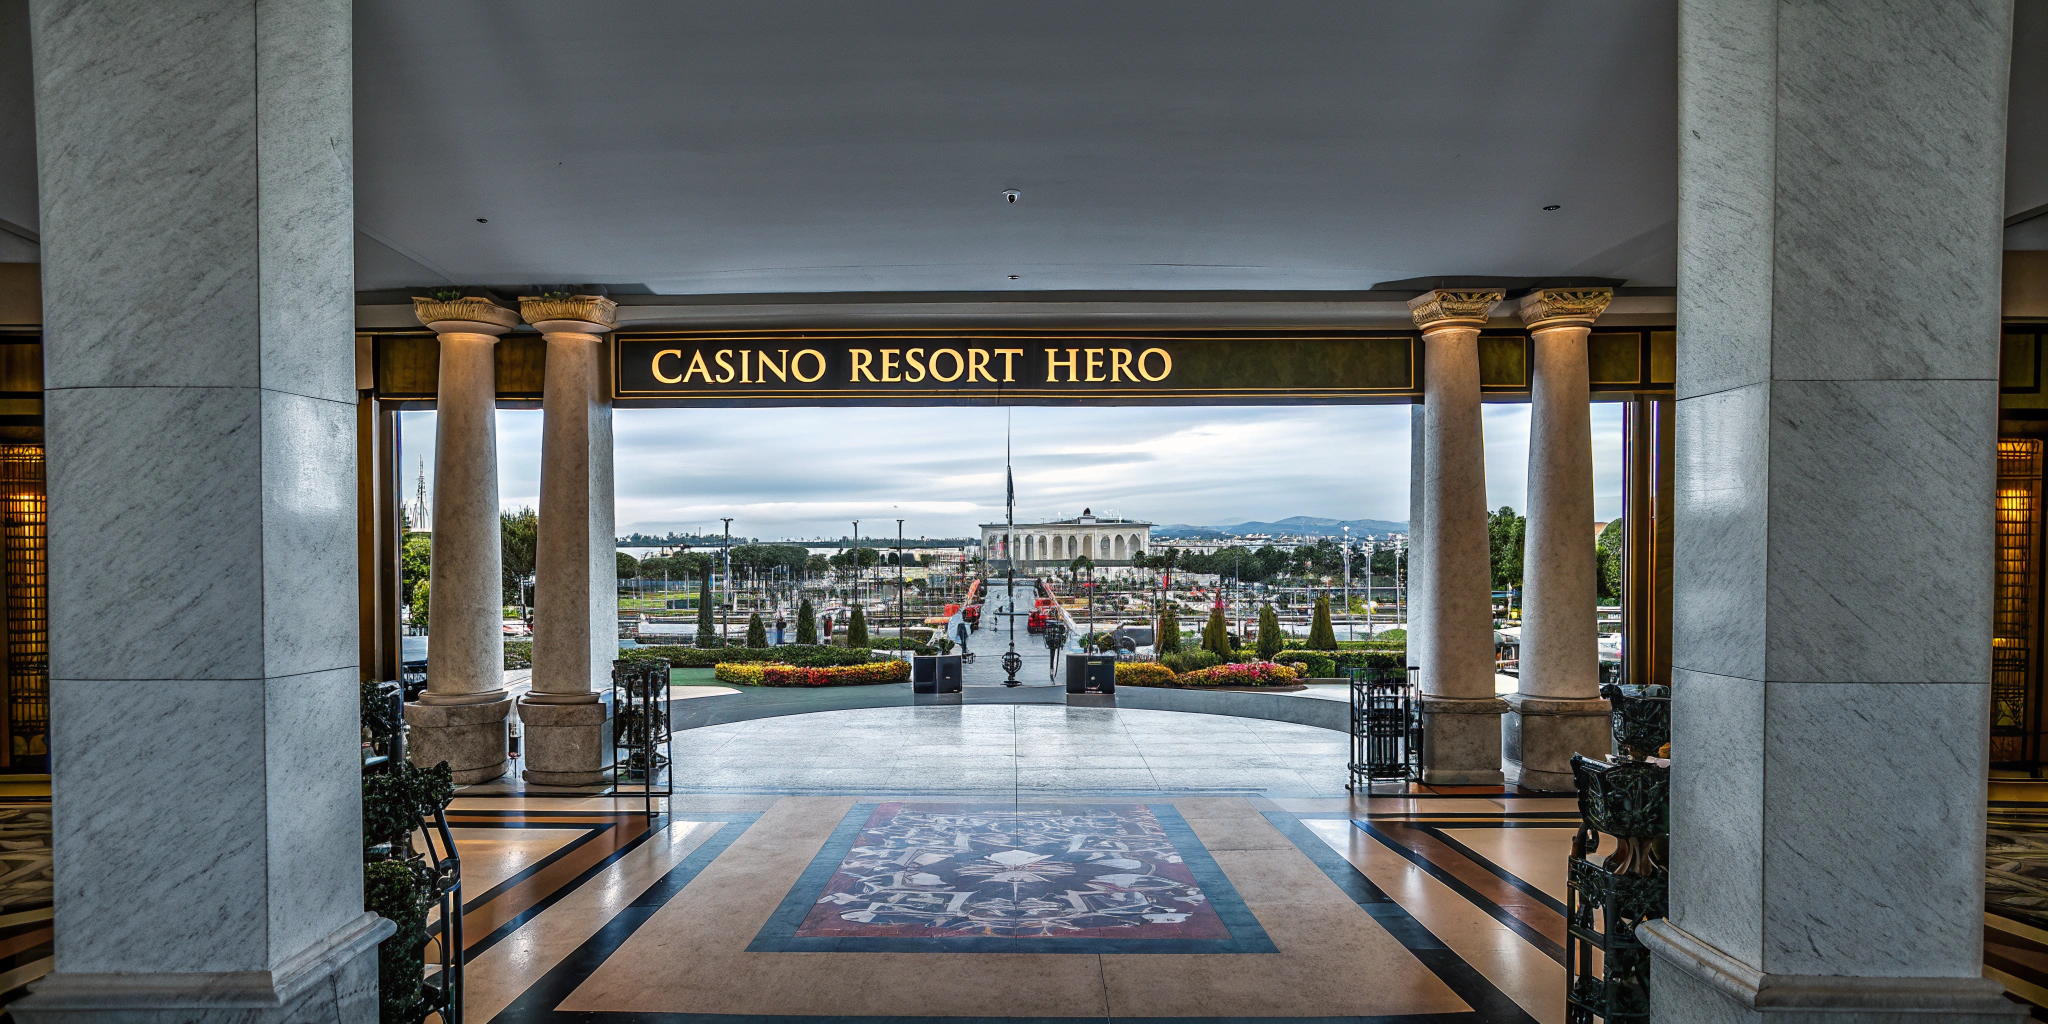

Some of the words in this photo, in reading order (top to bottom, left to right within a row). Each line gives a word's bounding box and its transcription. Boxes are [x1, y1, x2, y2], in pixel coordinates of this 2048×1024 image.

[651, 348, 827, 384] CASINO
[848, 347, 1024, 383] RESORT
[1044, 347, 1172, 383] HERO
